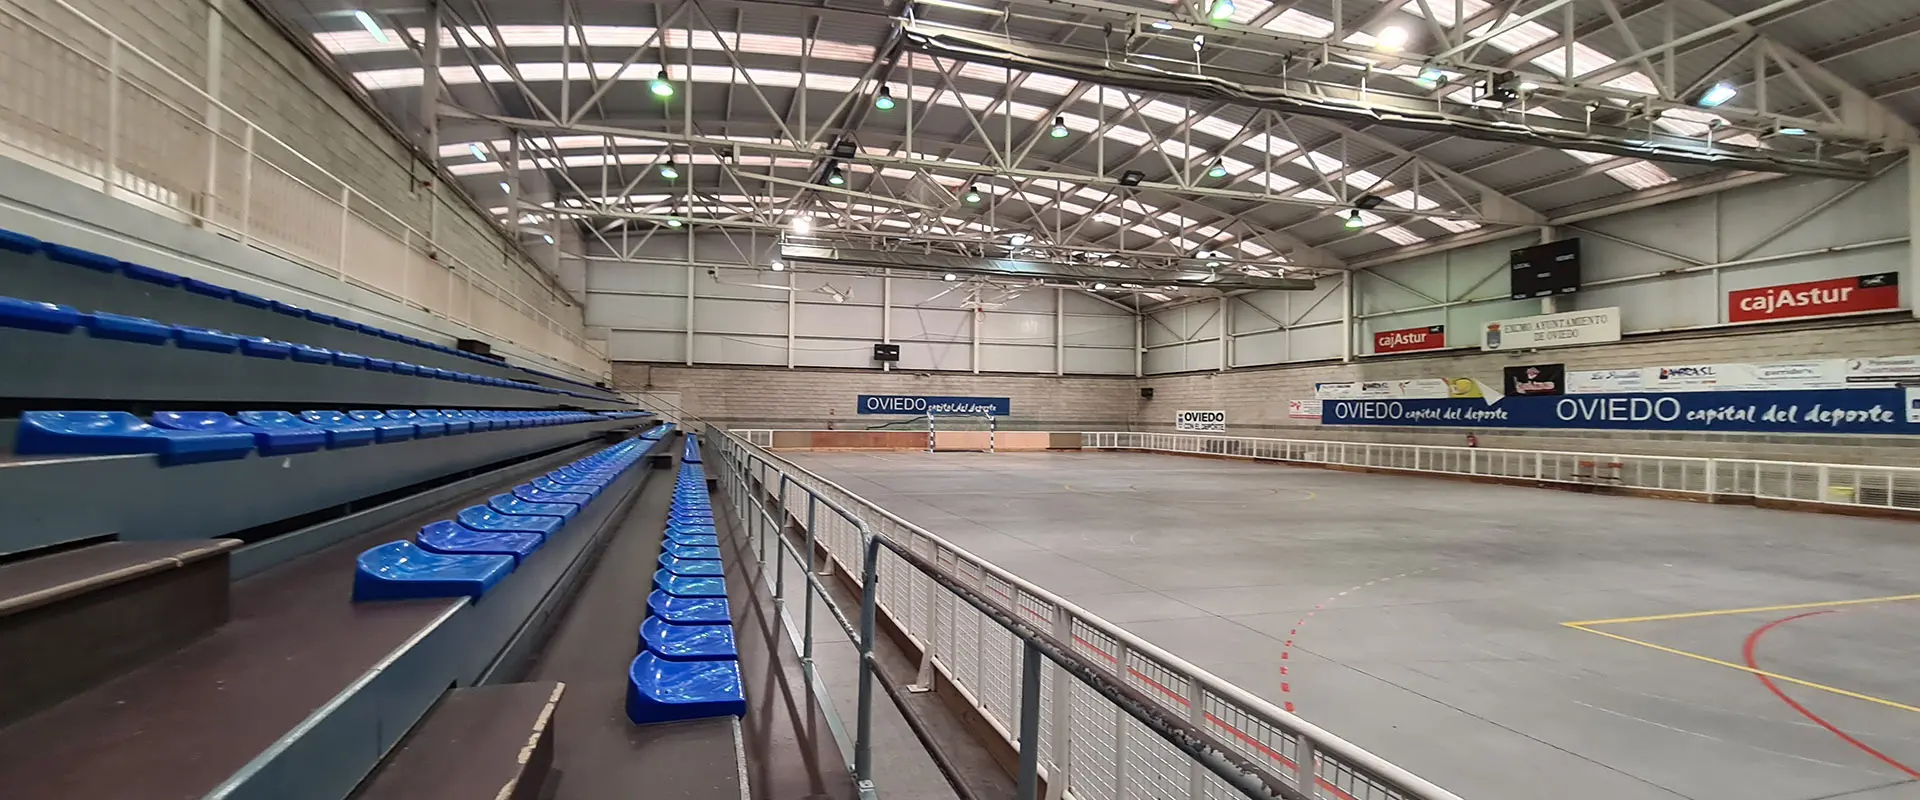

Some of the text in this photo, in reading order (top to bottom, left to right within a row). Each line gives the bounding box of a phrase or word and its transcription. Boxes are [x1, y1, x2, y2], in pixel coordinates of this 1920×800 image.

[1740, 286, 1853, 314] cajAstur
[1535, 314, 1608, 330] AYUNTAMIENTO
[1379, 332, 1427, 348] cajAstur
[1534, 329, 1579, 341] DE OVIEDO
[867, 397, 927, 411] OVIEDO
[1335, 401, 1403, 420] OVIEDO
[1405, 408, 1441, 422] capital
[1443, 407, 1463, 420] del
[1464, 407, 1508, 422] deporte
[1556, 397, 1895, 427] OVIEDO capital del deporte
[1184, 412, 1224, 422] OVIEDO
